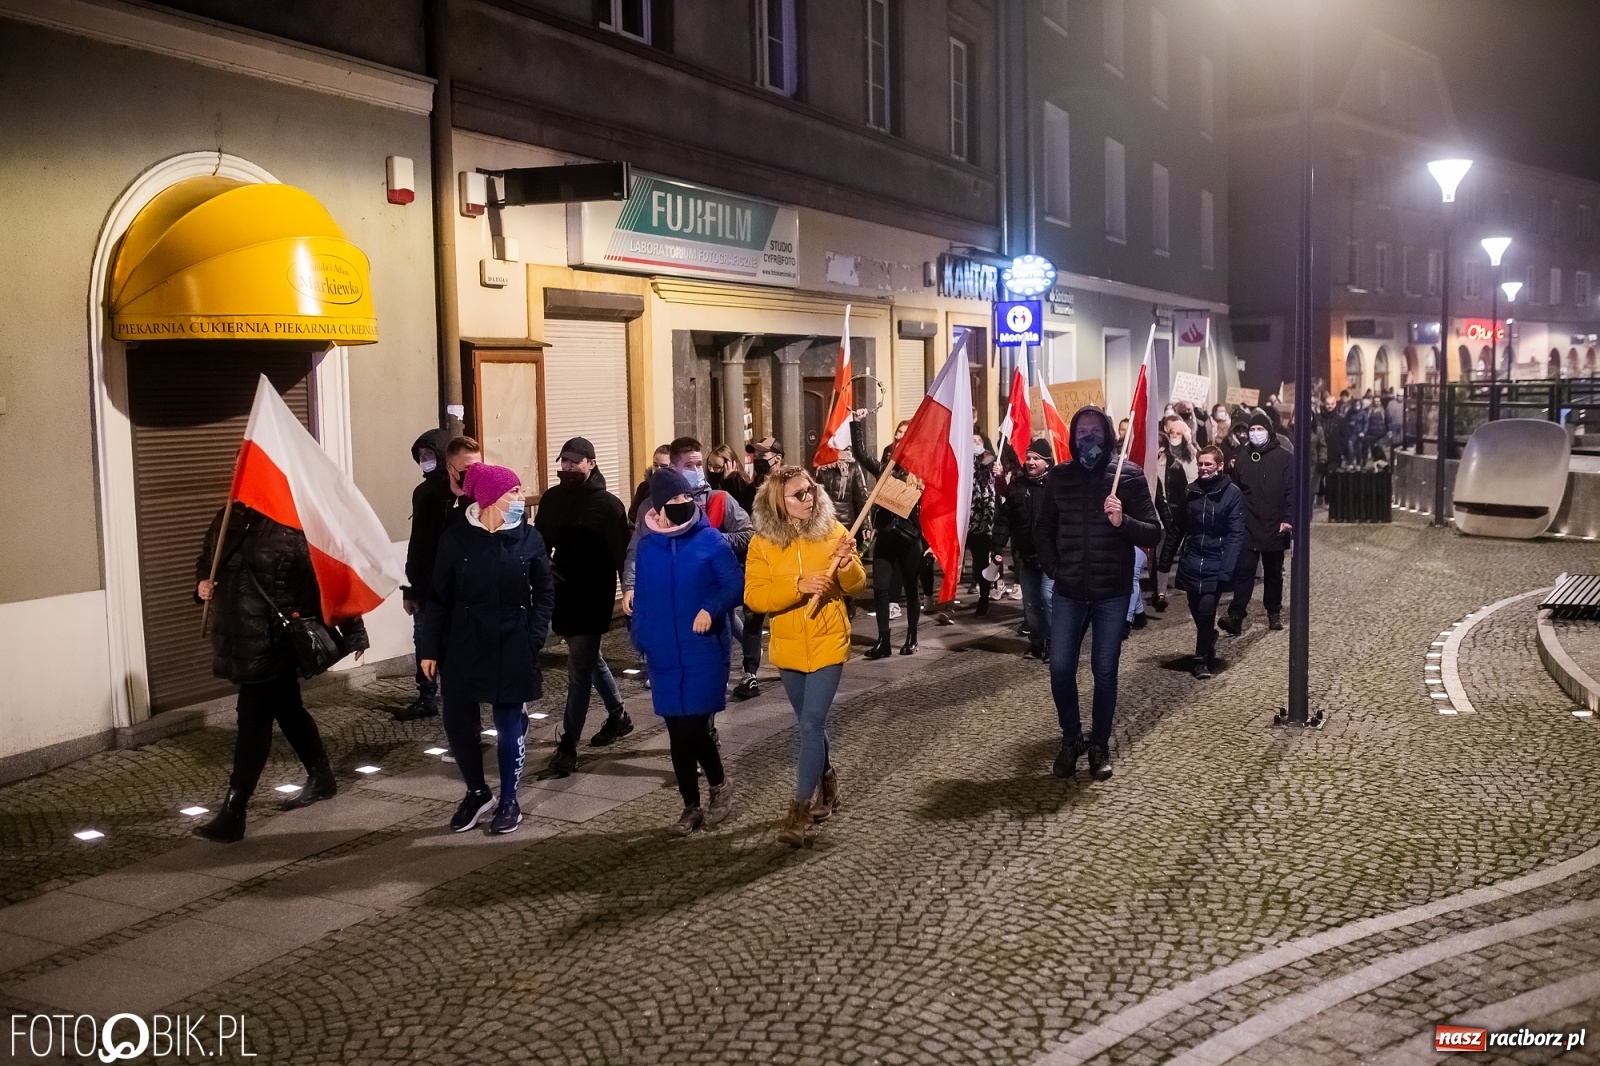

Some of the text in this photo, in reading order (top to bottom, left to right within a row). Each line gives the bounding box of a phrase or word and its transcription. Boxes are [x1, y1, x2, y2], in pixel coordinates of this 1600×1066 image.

[652, 190, 751, 242] FUJIFILM
[630, 239, 758, 269] LABORATORIUM FOTOGRAFICZNE
[770, 240, 793, 253] STUDIO
[763, 253, 795, 266] CYFR@FOTO
[299, 275, 359, 295] Markiewka
[944, 256, 998, 301] KANTOR
[118, 322, 186, 334] PIEKARNIA
[189, 321, 270, 333] CUKIERNIA
[274, 322, 337, 334] PIEKARNIA
[1064, 390, 1102, 402] POLSKA
